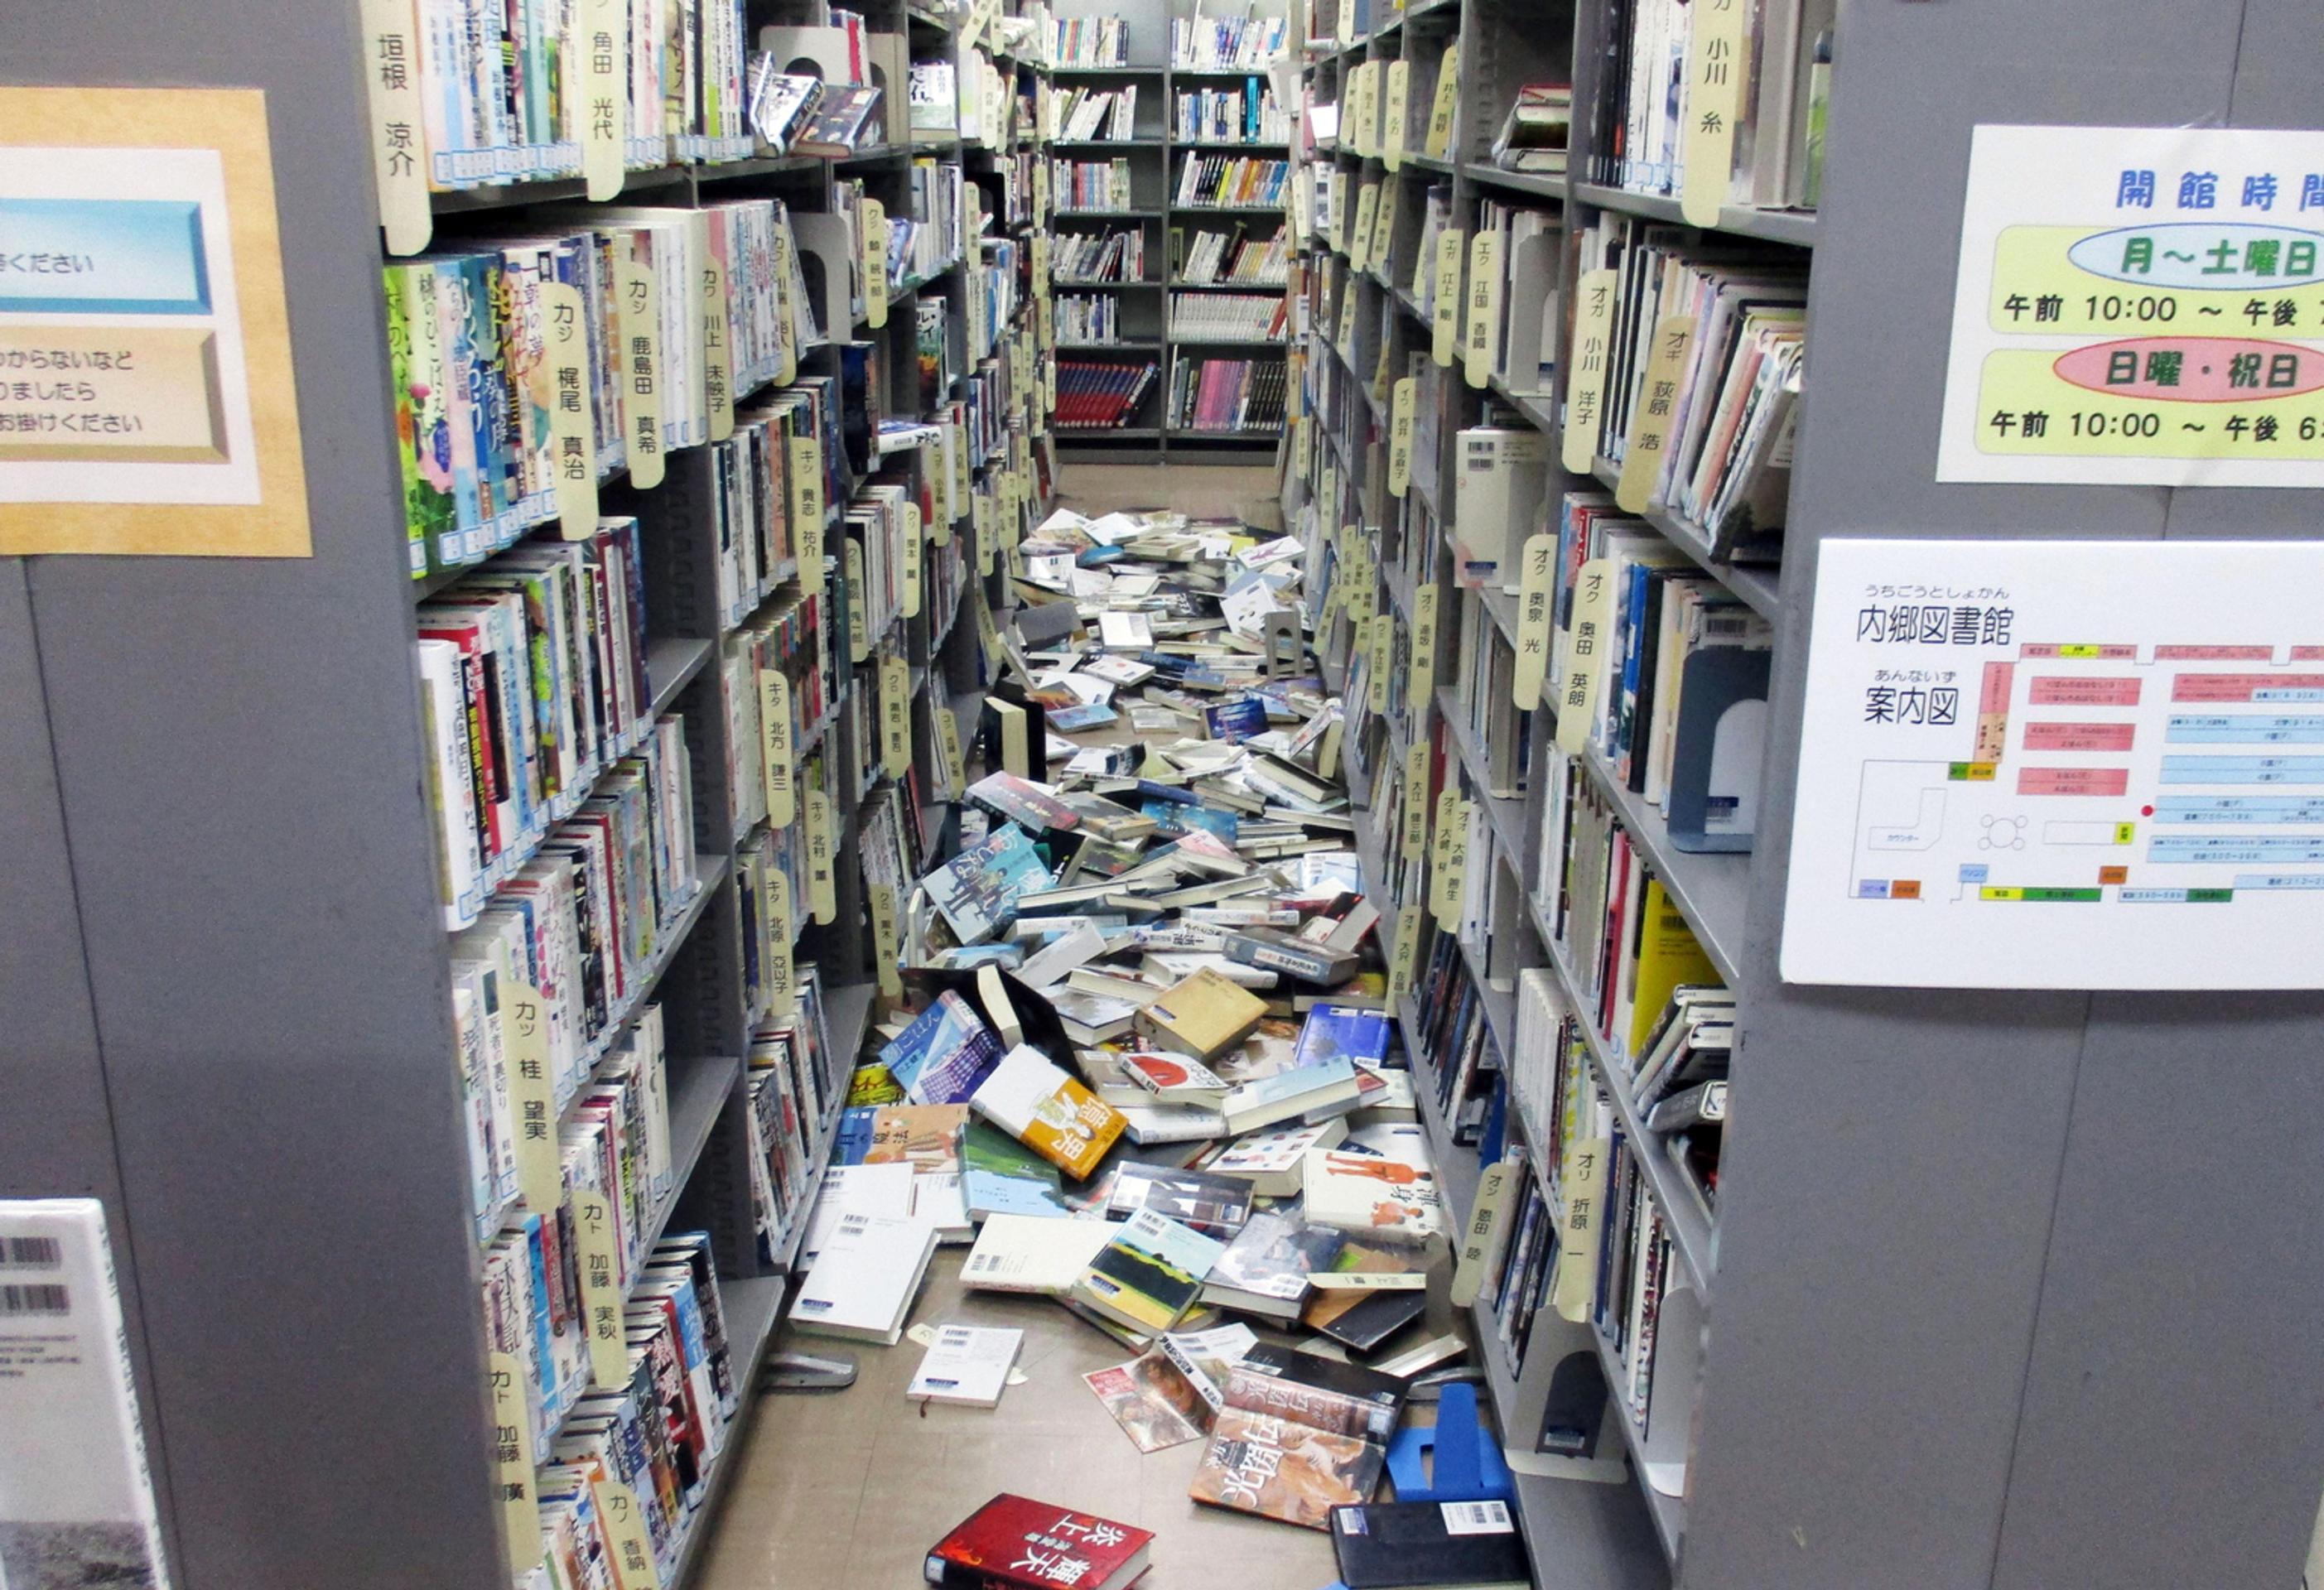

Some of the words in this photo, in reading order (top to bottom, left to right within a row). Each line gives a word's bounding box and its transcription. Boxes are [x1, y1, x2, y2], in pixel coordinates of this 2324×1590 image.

[378, 33, 408, 91] 垣根
[593, 31, 613, 75] 角田
[1704, 37, 1729, 86] 小川
[593, 98, 613, 141] 光代
[1700, 111, 1723, 134] 糸
[385, 122, 415, 177] 涼介
[1441, 273, 1454, 297] 江上
[2003, 294, 2063, 323] 午前
[2085, 296, 2177, 322] 10:00
[2243, 299, 2297, 327] 午後
[704, 315, 722, 349] 川上
[0, 350, 134, 370] からないなど
[632, 335, 653, 396] 鹿島田
[1582, 337, 1603, 372] 小川
[557, 367, 581, 414] 梶尾
[1576, 390, 1597, 425] 洋子
[1647, 380, 1676, 417] 荻原
[637, 415, 658, 455] 真希
[1637, 432, 1660, 451] 浩
[1990, 411, 2049, 438] 午前
[2070, 412, 2160, 437] 10:00
[2225, 415, 2279, 443] 午後
[562, 436, 586, 481] 真治
[801, 488, 816, 518] 貴志
[803, 530, 817, 558] 祐介
[1527, 592, 1545, 624] 奥泉
[1864, 584, 2010, 600] うちごうとしょかん
[1576, 621, 1595, 656] 奥田
[1857, 604, 2015, 646] 内郷図書館
[1525, 638, 1540, 654] 光
[1567, 672, 1589, 707] 英朗
[1874, 669, 1957, 684] あんないず
[1864, 686, 1960, 726] 案内図
[769, 721, 785, 751] 北方
[771, 763, 788, 792] 謙三
[812, 835, 827, 859] 北村
[769, 917, 785, 942] 北原
[519, 1058, 543, 1081] 桂
[1473, 1208, 1492, 1236] 恩田
[1569, 1197, 1591, 1231] 折原
[589, 1253, 610, 1289] 加藤
[496, 1424, 522, 1463] 加藤
[622, 1539, 648, 1572] 香納
